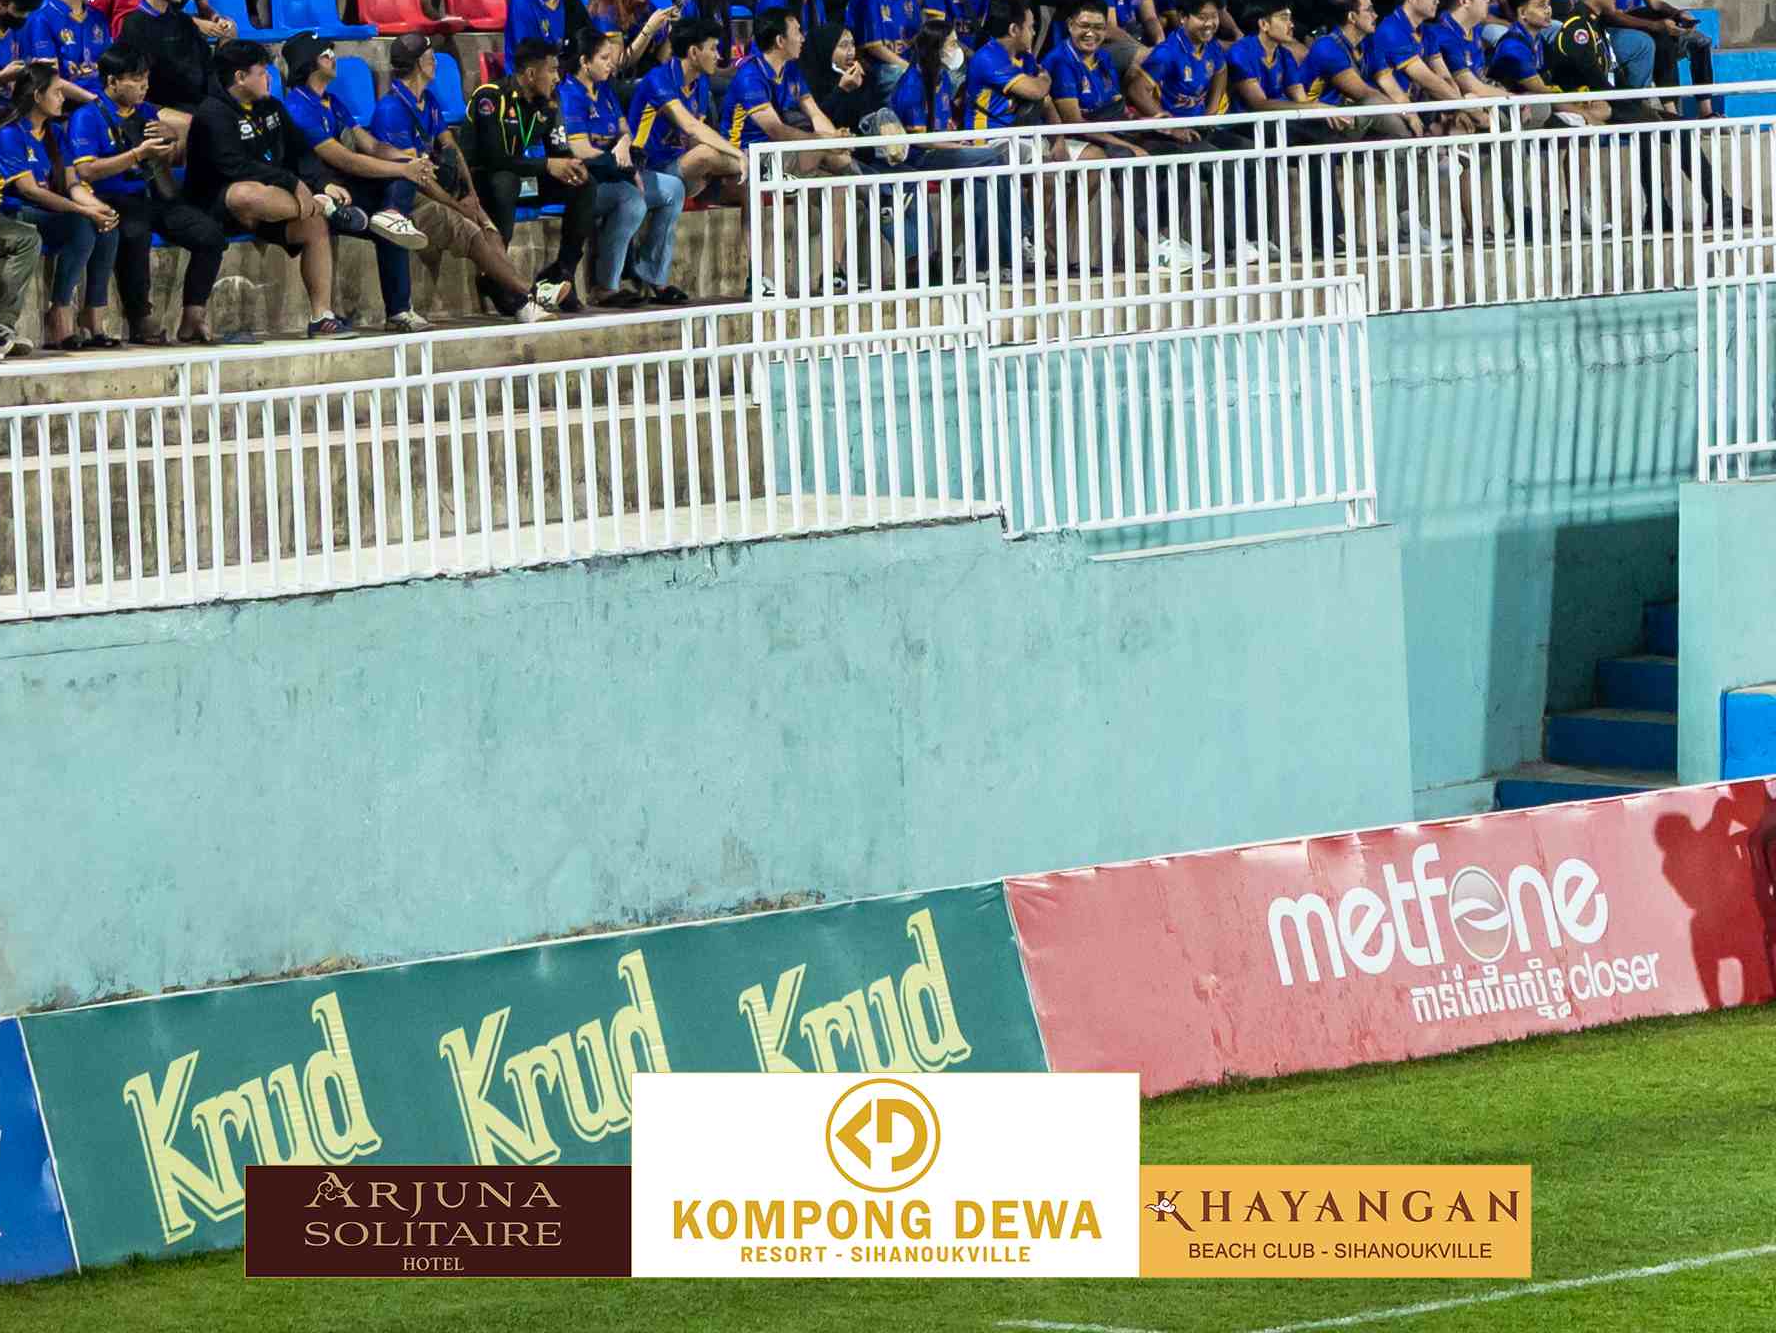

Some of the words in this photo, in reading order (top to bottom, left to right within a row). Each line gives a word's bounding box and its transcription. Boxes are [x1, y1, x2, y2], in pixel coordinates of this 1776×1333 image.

[1267, 843, 1609, 986] metfone
[1575, 953, 1660, 1000] closer
[125, 992, 381, 1245] Krud
[440, 949, 672, 1166] Krud
[740, 908, 971, 1073] Krud
